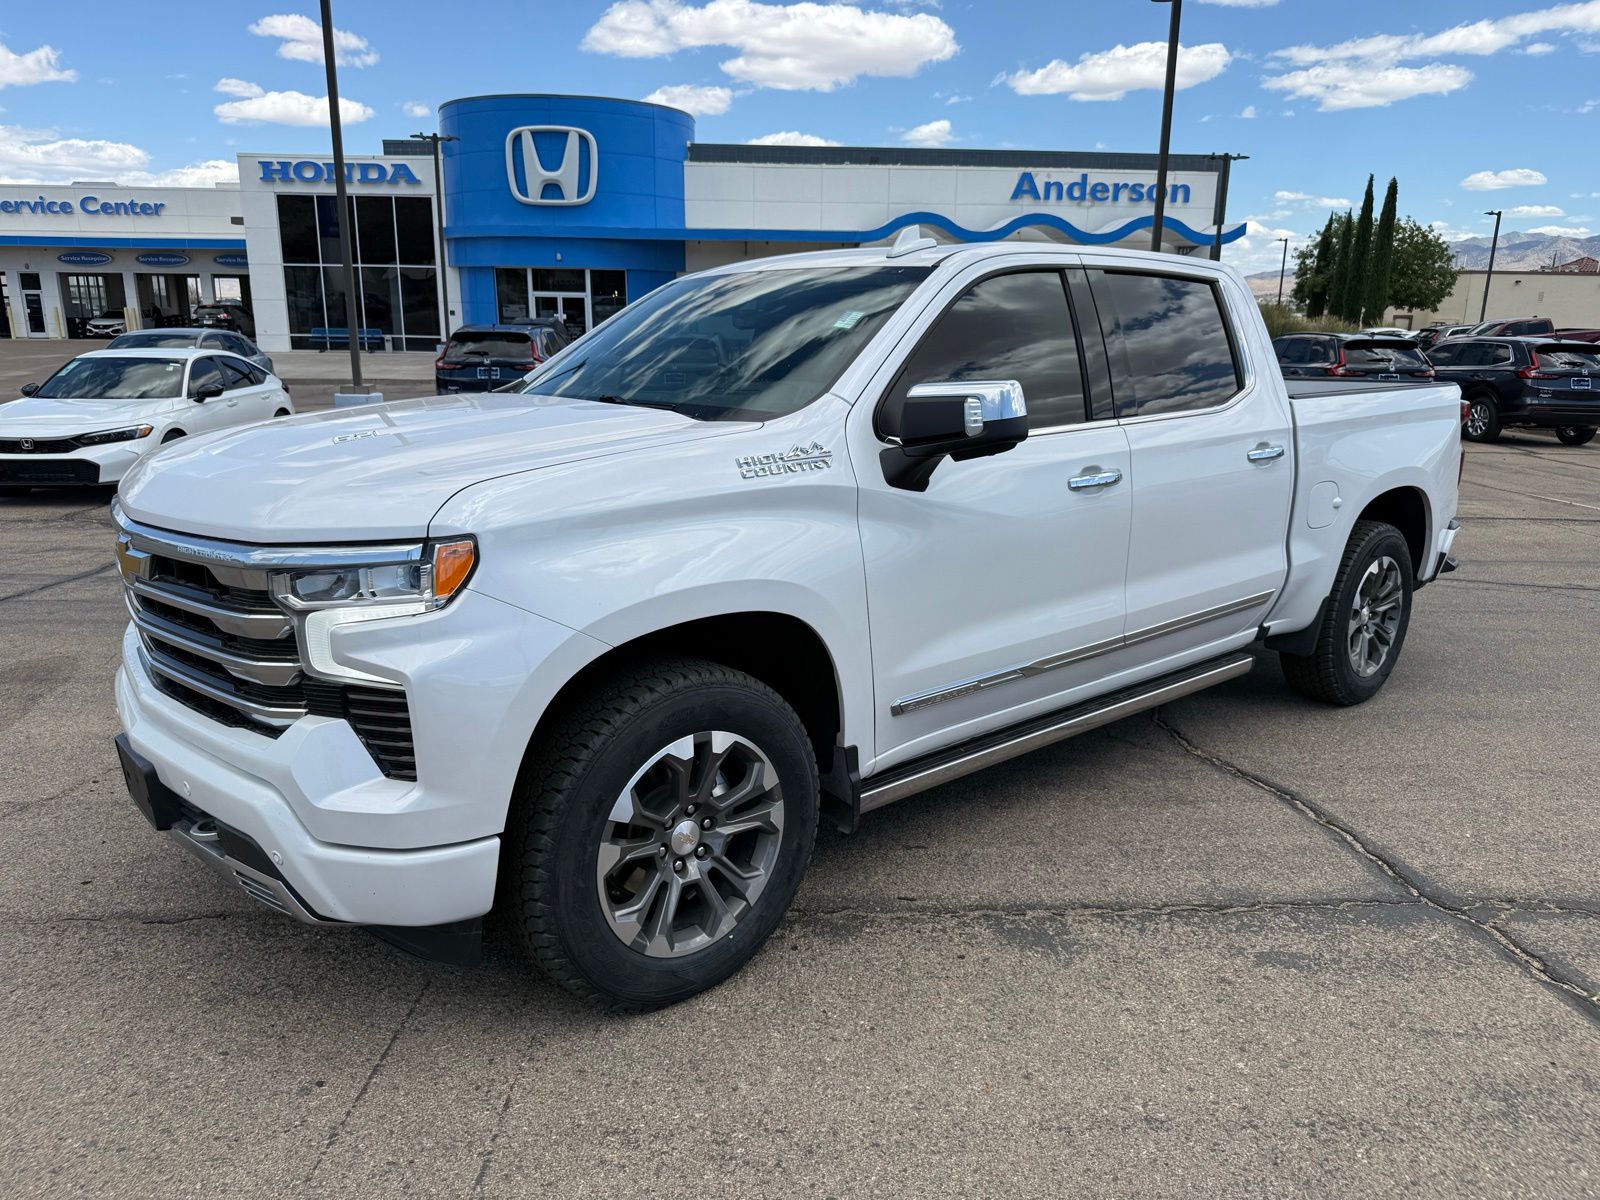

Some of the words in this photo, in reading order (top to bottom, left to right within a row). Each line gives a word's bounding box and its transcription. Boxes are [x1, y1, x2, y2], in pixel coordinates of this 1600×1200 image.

[1009, 172, 1191, 203] Anderson
[0, 195, 73, 215] ervice
[79, 196, 165, 216] Center
[735, 453, 786, 468] HIGH
[740, 459, 833, 479] COUNTRY
[176, 545, 194, 555] HIGH
